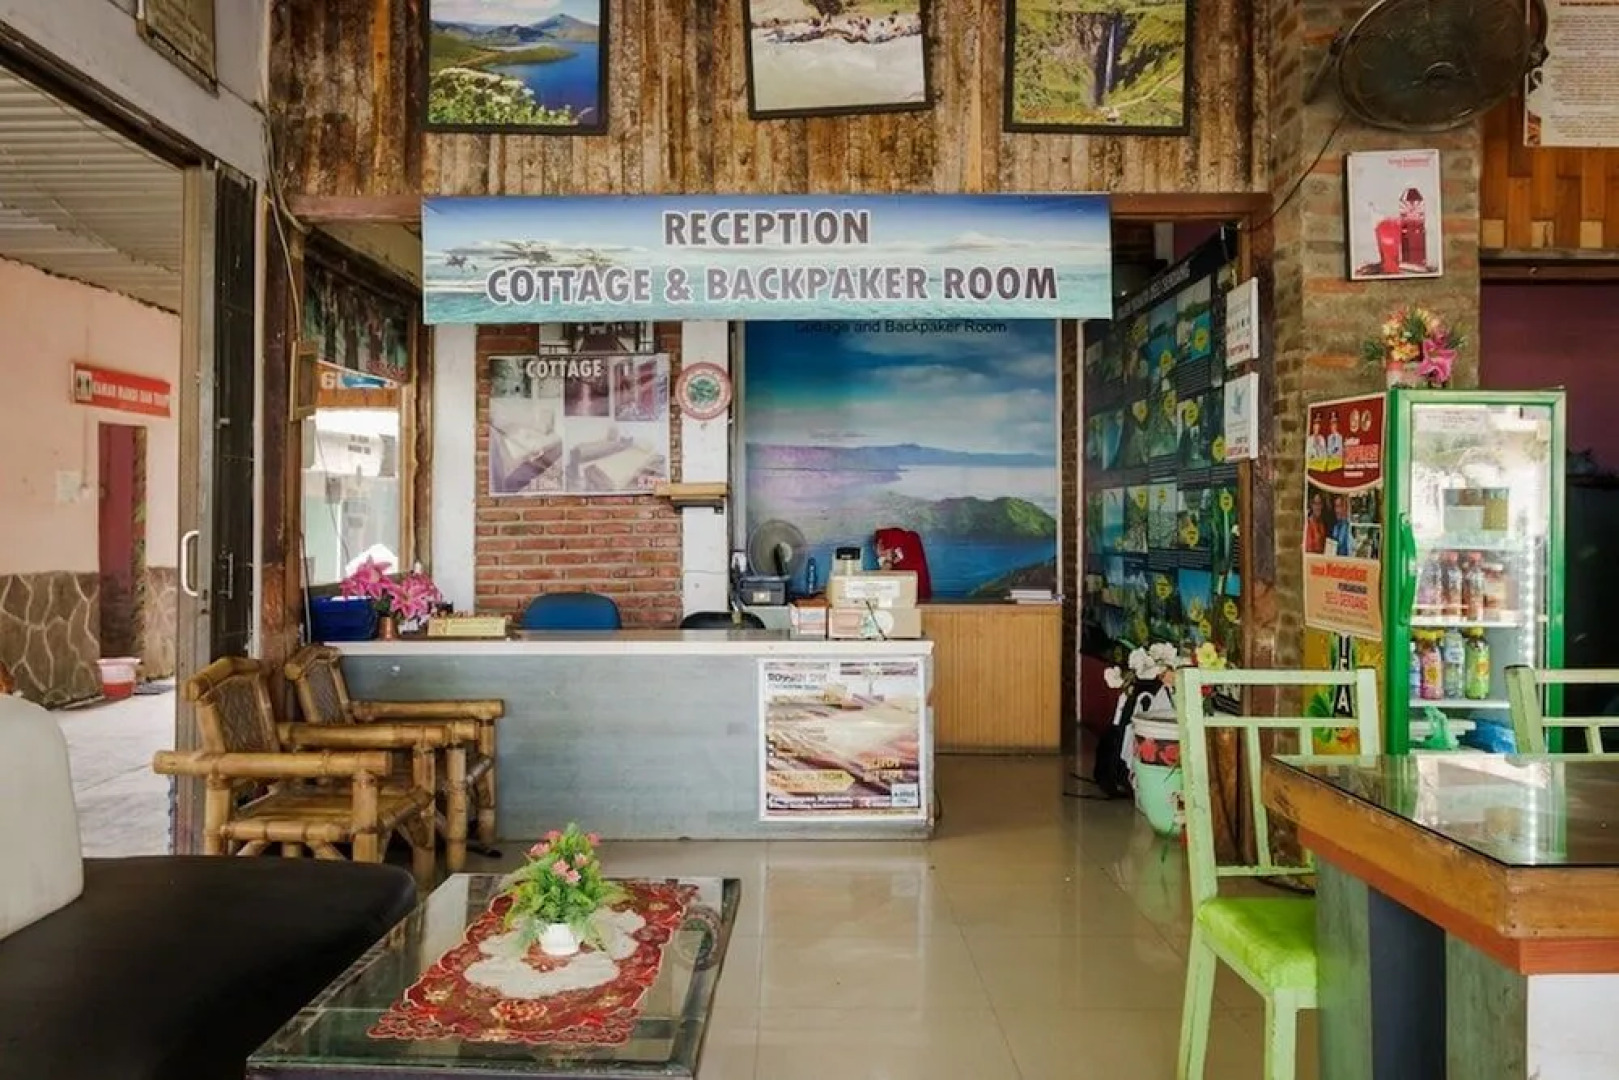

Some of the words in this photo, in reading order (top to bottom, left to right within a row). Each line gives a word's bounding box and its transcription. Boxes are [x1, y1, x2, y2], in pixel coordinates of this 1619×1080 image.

[663, 210, 870, 246] RECEPTION
[486, 267, 651, 303] COTTAGE
[664, 266, 693, 302] &
[706, 266, 928, 301] BACKPAKER
[943, 265, 1058, 301] ROOM
[853, 319, 880, 333] and
[885, 319, 958, 335] Backpaker
[964, 319, 1007, 333] Room
[525, 359, 602, 378] COTTAGE
